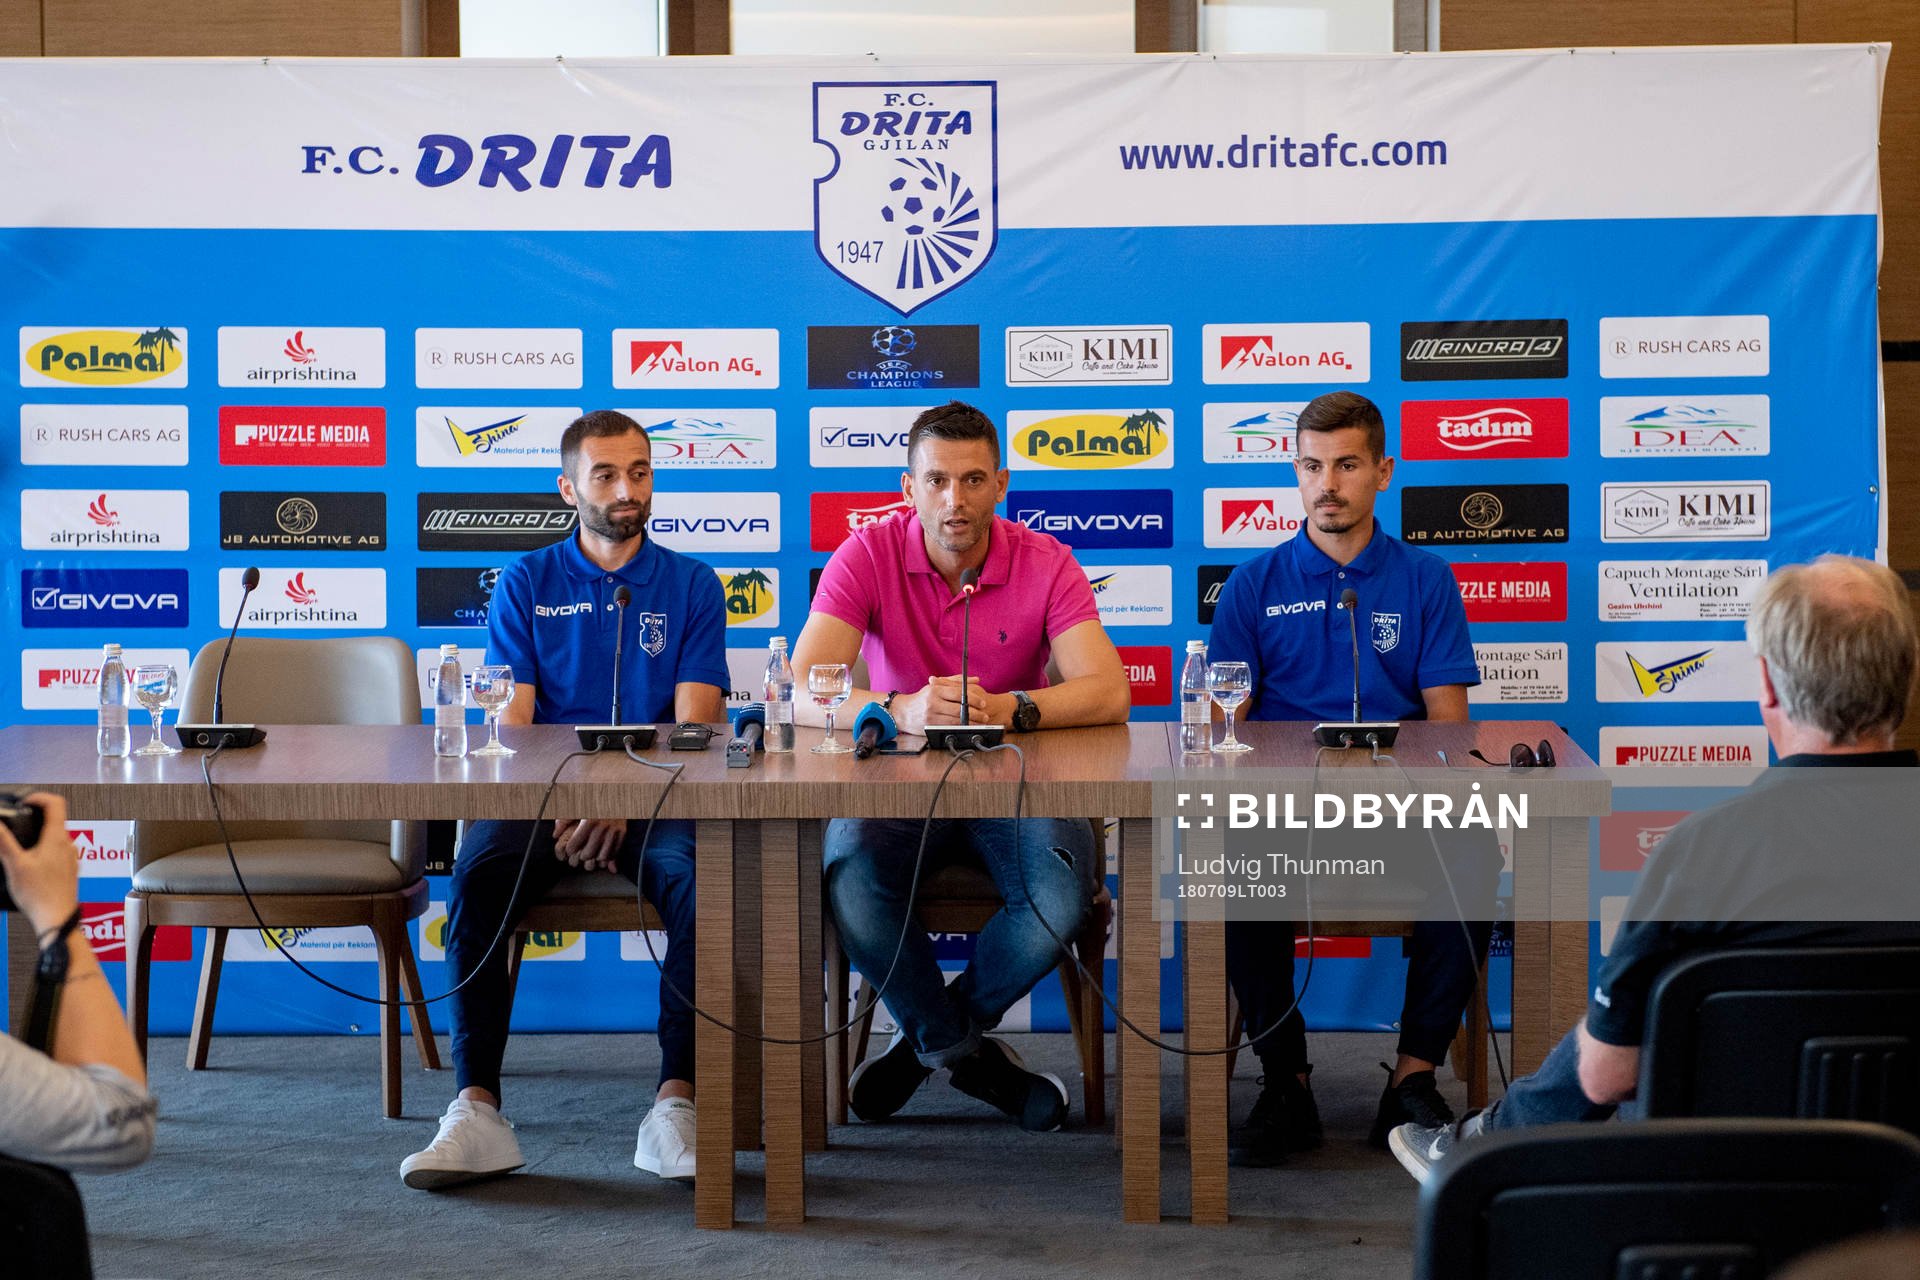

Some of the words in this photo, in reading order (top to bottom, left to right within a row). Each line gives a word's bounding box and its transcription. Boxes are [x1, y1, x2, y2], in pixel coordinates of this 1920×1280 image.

[884, 93, 934, 106] F.C.
[840, 110, 972, 137] DRITA
[863, 139, 950, 151] GJILAN
[1119, 132, 1448, 170] www.dritafc.com
[301, 145, 399, 175] F.C.
[415, 133, 672, 193] DRITA
[836, 240, 884, 264] 1947
[1082, 338, 1159, 361] KIMI
[1439, 340, 1526, 354] RINORA
[1533, 340, 1552, 352] 4
[1638, 340, 1682, 354] RUSH
[1687, 340, 1731, 353] CARS
[1736, 339, 1761, 353] AG
[41, 344, 160, 372] Palma
[454, 352, 497, 365] RUSH
[501, 352, 545, 365] CARS
[550, 352, 575, 365] AG
[660, 356, 720, 372] Valon
[1029, 351, 1064, 362] KIMI
[1251, 352, 1311, 367] Valon
[879, 362, 908, 371] UEFA
[247, 367, 357, 384] airprishtina
[846, 370, 944, 380] CHAMPIONS
[870, 380, 920, 388] LEAGUE
[59, 429, 103, 442] RUSH
[107, 429, 151, 442] CARS
[156, 429, 181, 442] AG
[258, 425, 316, 442] PUZZLE
[320, 425, 370, 442] MEDIA
[471, 424, 519, 454] Shina
[847, 432, 909, 447] GIVO
[1633, 429, 1741, 447] DEA
[1028, 429, 1148, 457] Palma
[1624, 507, 1660, 518] KIMI
[1679, 493, 1757, 517] KIMI
[455, 513, 541, 526] RINORA
[549, 513, 567, 526] 4
[651, 518, 770, 533] GIVOVA
[1044, 514, 1163, 530] GIVOVA
[50, 530, 160, 547] airprishtina
[223, 535, 243, 545] JB
[249, 535, 352, 544] AUTOMOTIVE
[358, 535, 380, 544] AG
[1407, 530, 1427, 540] JB
[1433, 529, 1537, 539] AUTOMOTIVE
[1543, 528, 1565, 538] AG
[1604, 567, 1660, 581] Capuch
[1664, 565, 1730, 580] Montage
[1459, 581, 1497, 598] ZZLE
[1501, 581, 1551, 598] MEDIA
[1628, 582, 1739, 598] Ventilation
[58, 593, 179, 610] GIVOVA
[535, 601, 592, 617] GIVOVA
[1266, 600, 1326, 617] GIVOVA
[248, 608, 358, 625] airprishtina
[1374, 617, 1397, 625] DRITA
[62, 668, 100, 685] PUZZ
[1654, 658, 1705, 694] Shina
[1639, 745, 1697, 762] PUZZLE
[1702, 745, 1752, 762] MEDIA
[424, 861, 445, 870] JB
